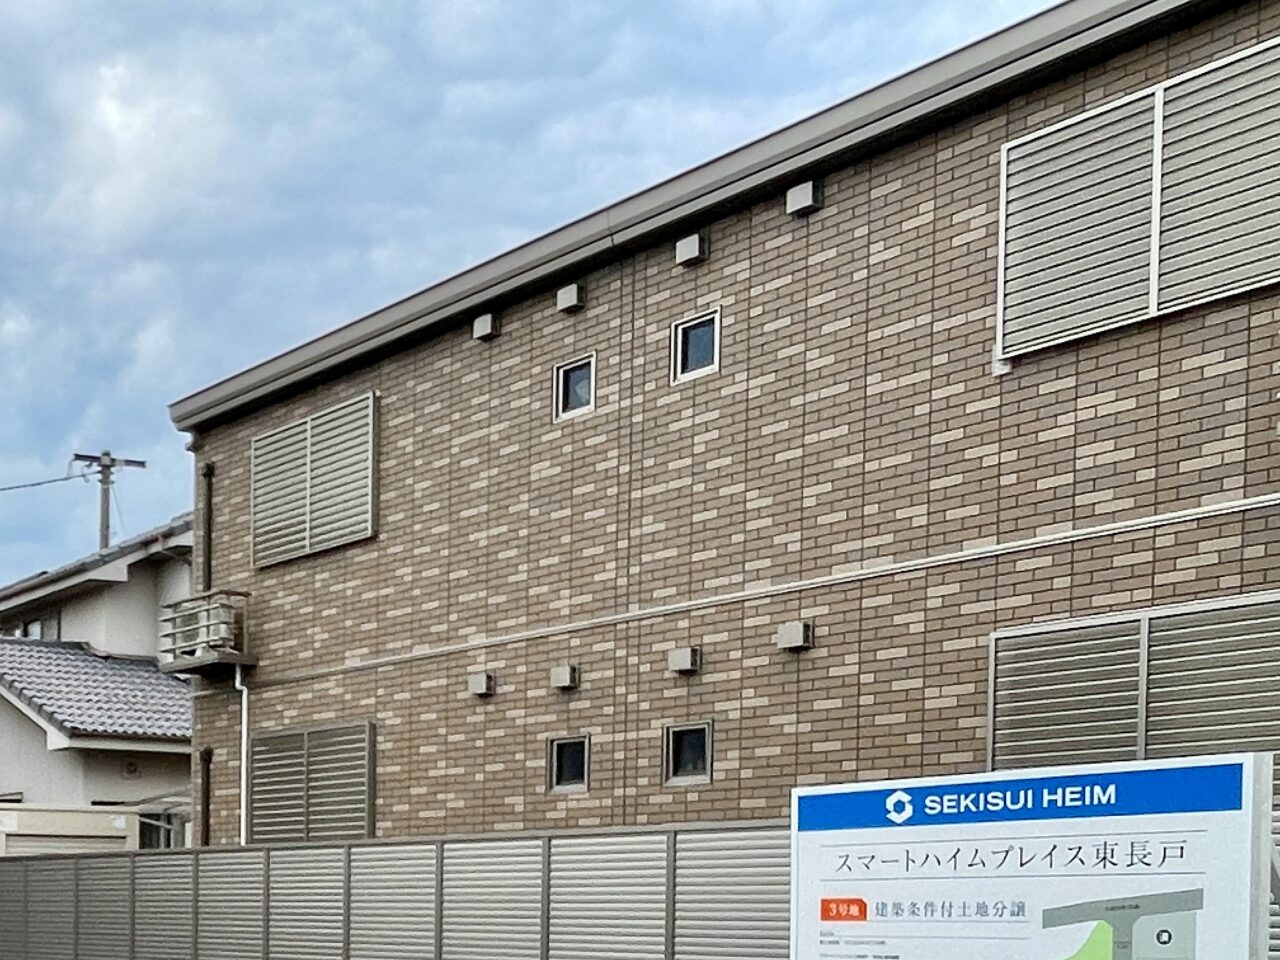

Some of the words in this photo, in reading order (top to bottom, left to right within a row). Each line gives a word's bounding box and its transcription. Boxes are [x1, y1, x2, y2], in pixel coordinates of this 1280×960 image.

[924, 788, 1033, 816] SEKISUI
[1042, 783, 1117, 808] HEIM
[835, 840, 1188, 874] スマートハイムプレイス東長戸
[875, 900, 1026, 918] 建築条件付土地分譲
